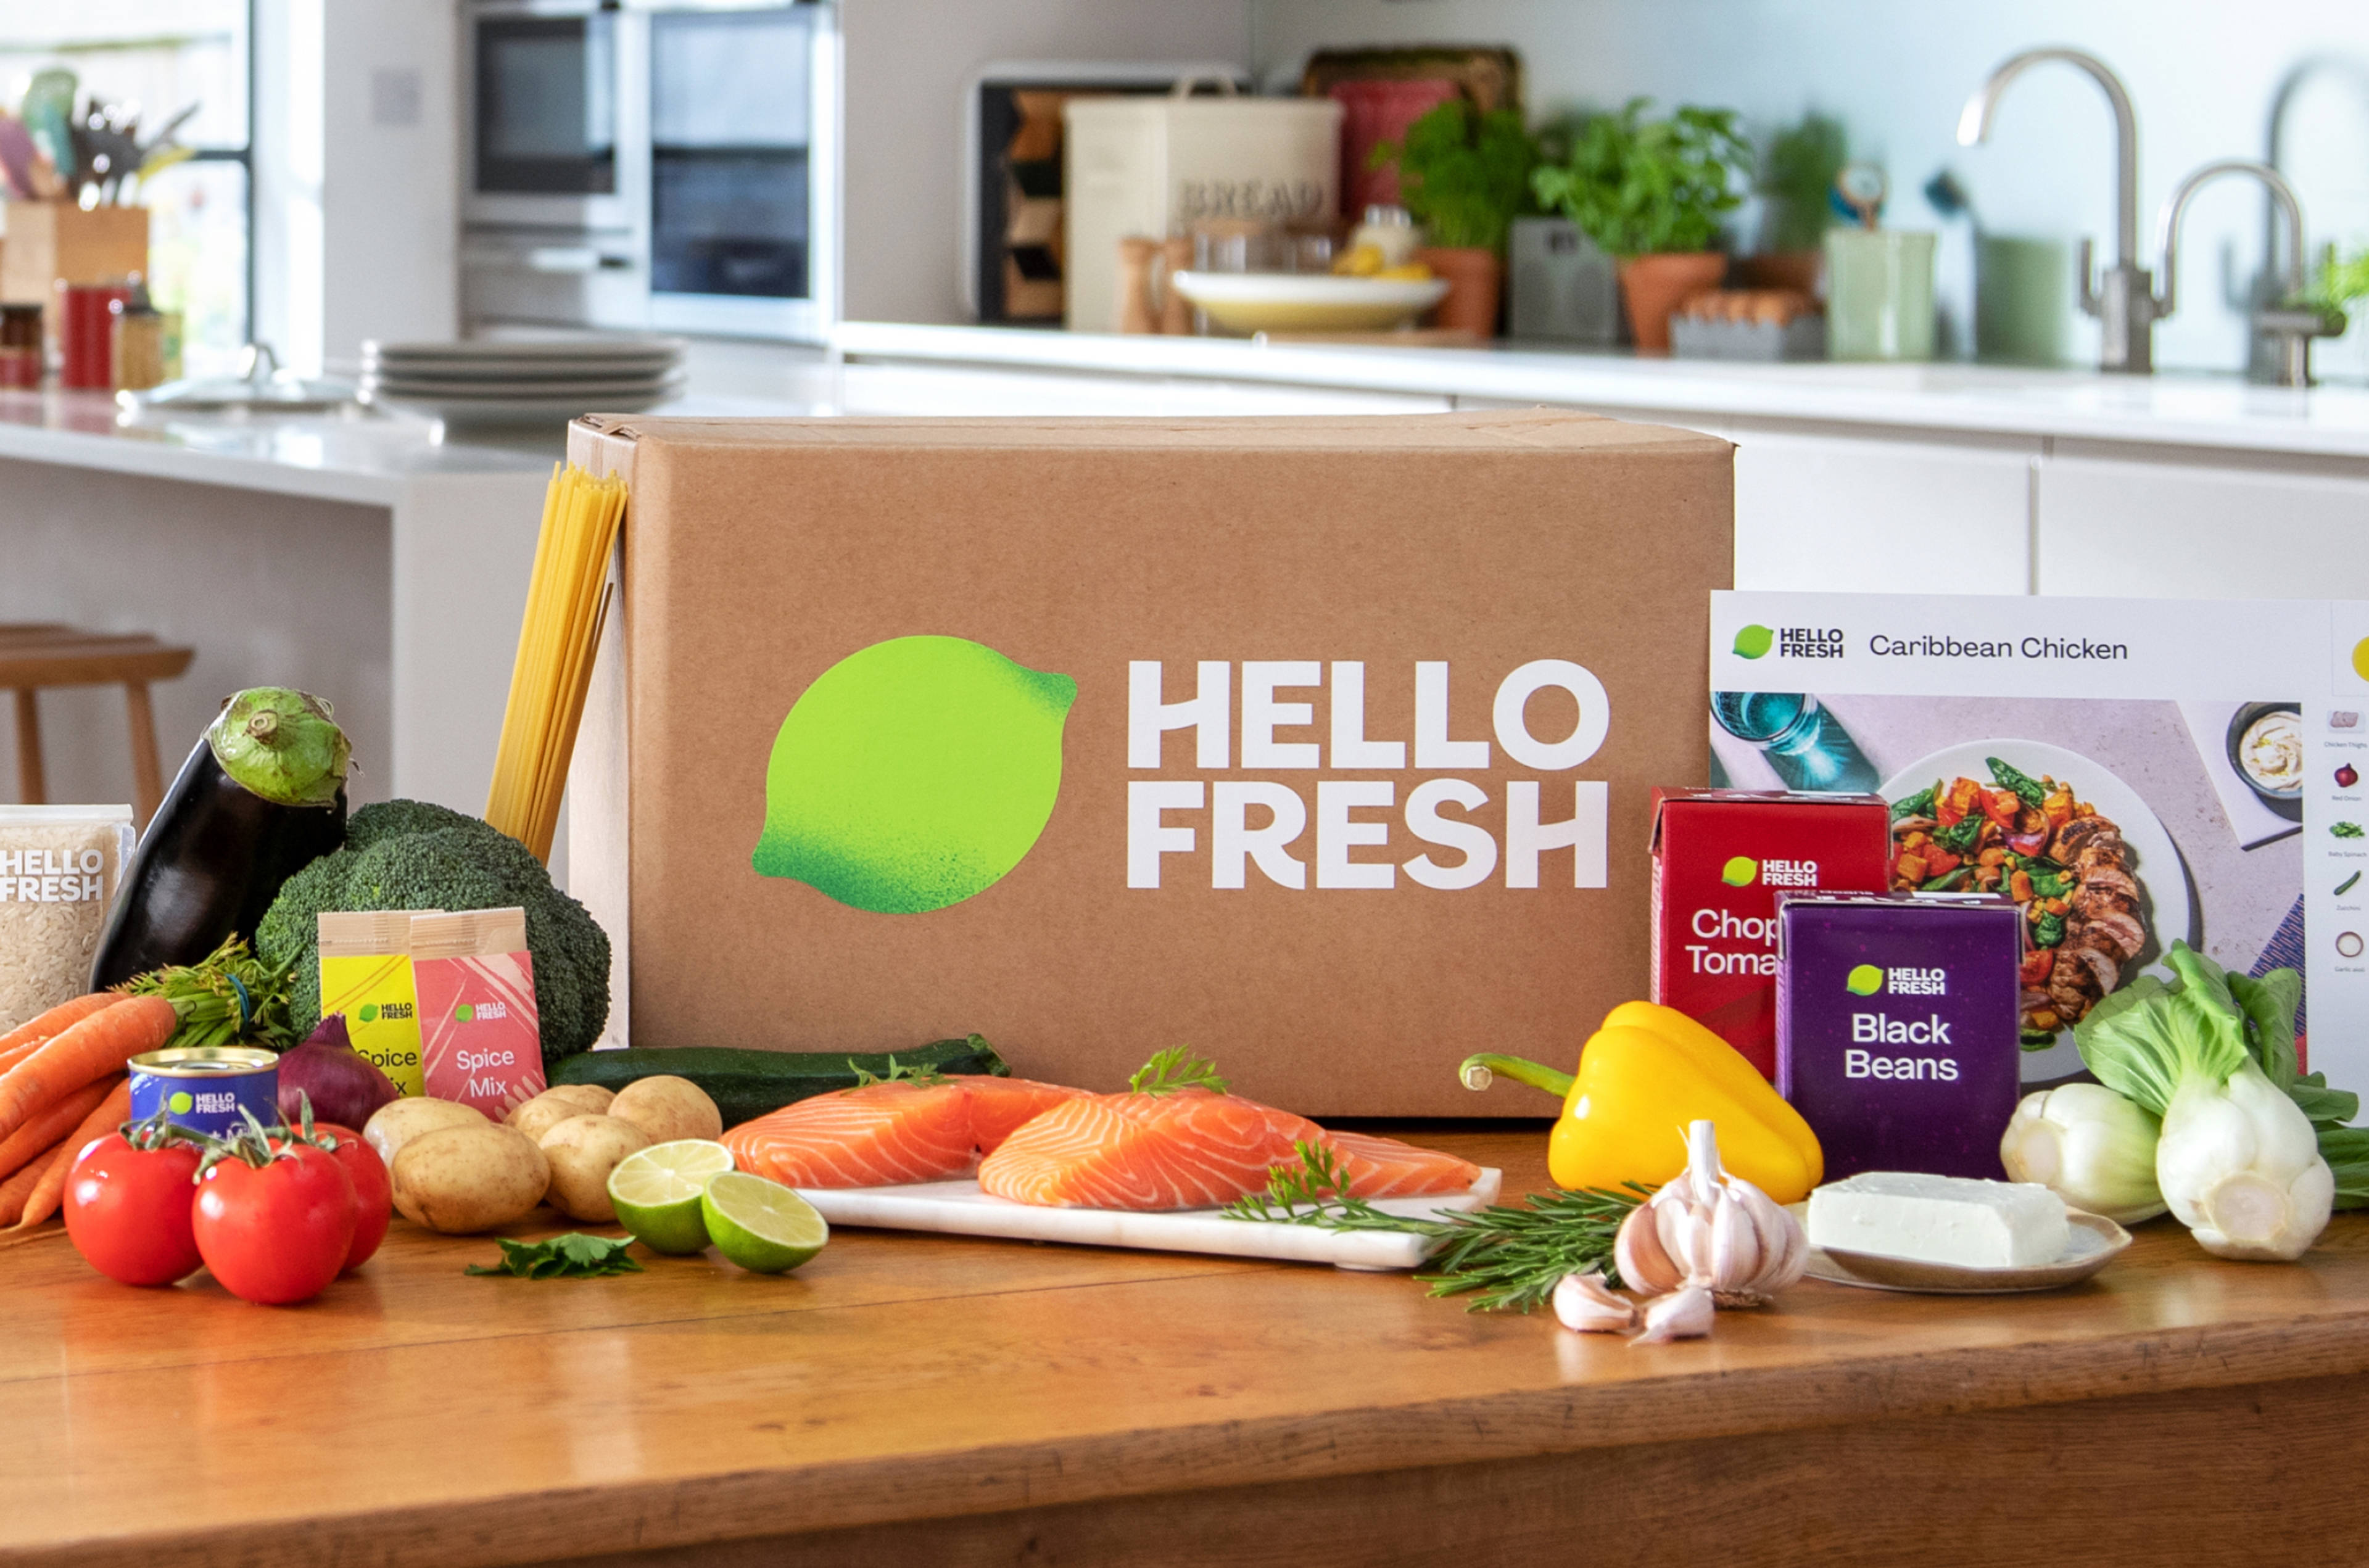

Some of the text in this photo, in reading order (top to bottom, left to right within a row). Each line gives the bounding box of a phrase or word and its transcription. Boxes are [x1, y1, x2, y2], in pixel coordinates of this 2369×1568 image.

[1182, 179, 1325, 217] BREAD
[1780, 628, 1843, 643] HELLO
[1780, 643, 1843, 658] FRESH
[1870, 635, 2128, 659] Caribbean Chicken
[1128, 659, 1610, 770] HELLO
[1127, 778, 1608, 889] FRESH
[0, 849, 104, 875] HELLO
[1763, 859, 1817, 873] HELLO
[1763, 872, 1817, 886] FRESH
[0, 875, 103, 902] FRESH
[1685, 945, 1776, 975] Toma
[1888, 967, 1945, 981] HELLO
[1888, 981, 1945, 995] FRESH
[381, 1002, 412, 1012] HELLO
[382, 1010, 413, 1020] FRESH
[476, 1001, 505, 1012] HELLO
[476, 1010, 506, 1021] FRESH
[1853, 1013, 1951, 1044] Black
[358, 1048, 417, 1068] pice
[457, 1048, 515, 1073] Spice
[1845, 1049, 1959, 1081] Beans
[470, 1076, 507, 1097] Mix
[196, 1092, 235, 1104] HELLO
[196, 1102, 234, 1113] FRESH
